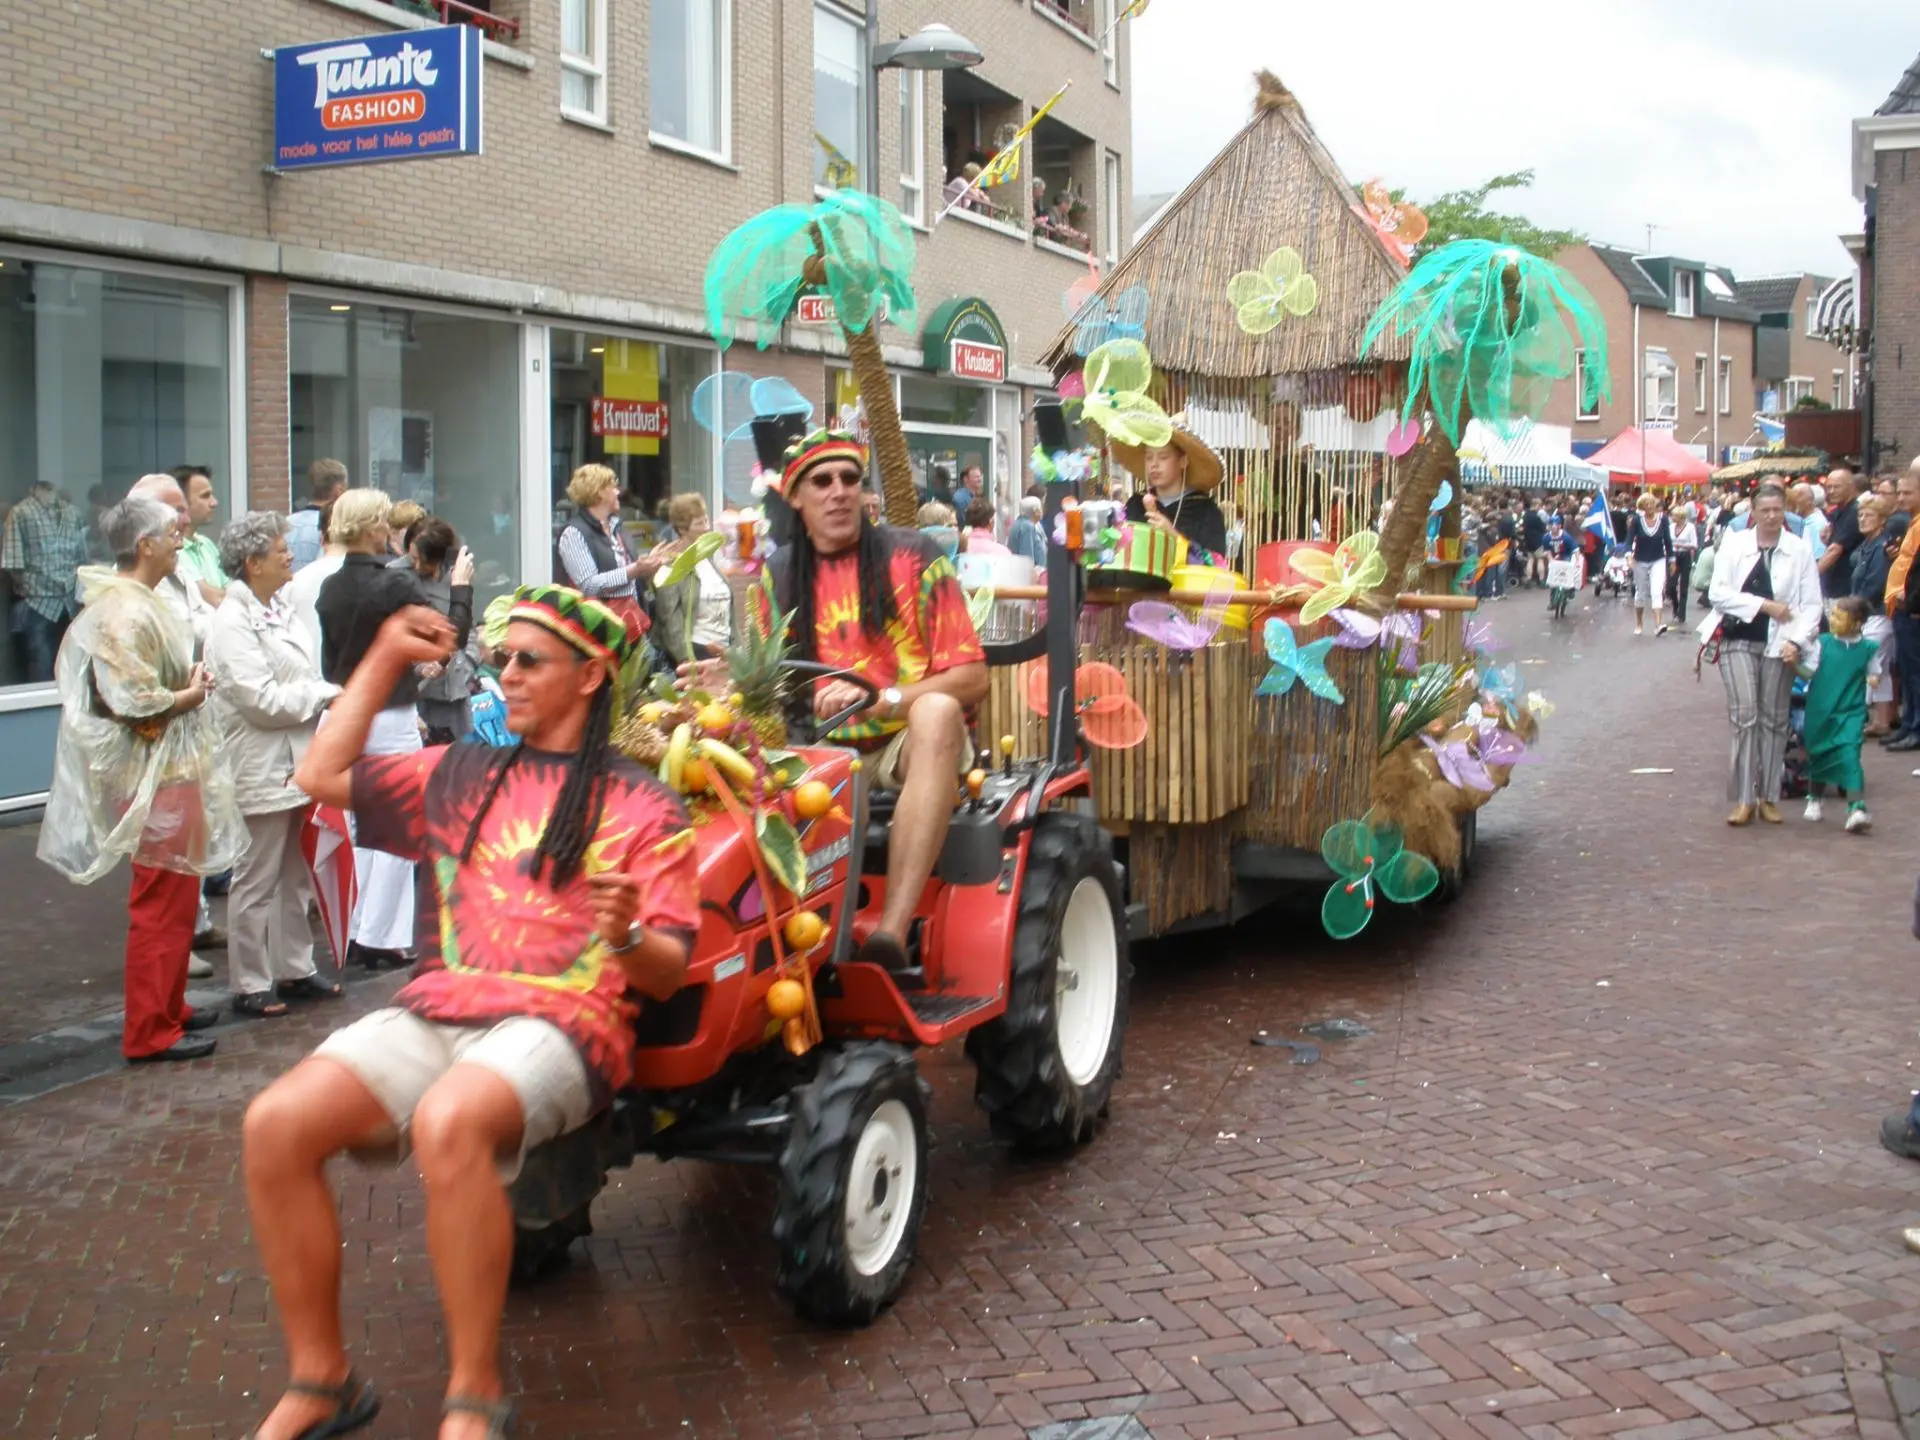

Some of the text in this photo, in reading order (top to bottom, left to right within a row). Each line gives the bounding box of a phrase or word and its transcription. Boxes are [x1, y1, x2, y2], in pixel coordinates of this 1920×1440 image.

[296, 41, 438, 108] Tuunte
[332, 97, 416, 123] FASHION
[280, 141, 317, 159] mode
[322, 139, 352, 155] voor
[356, 133, 378, 152] het
[418, 127, 455, 147] gezin
[964, 347, 995, 374] Kruidvat
[603, 402, 660, 432] Kruidvat
